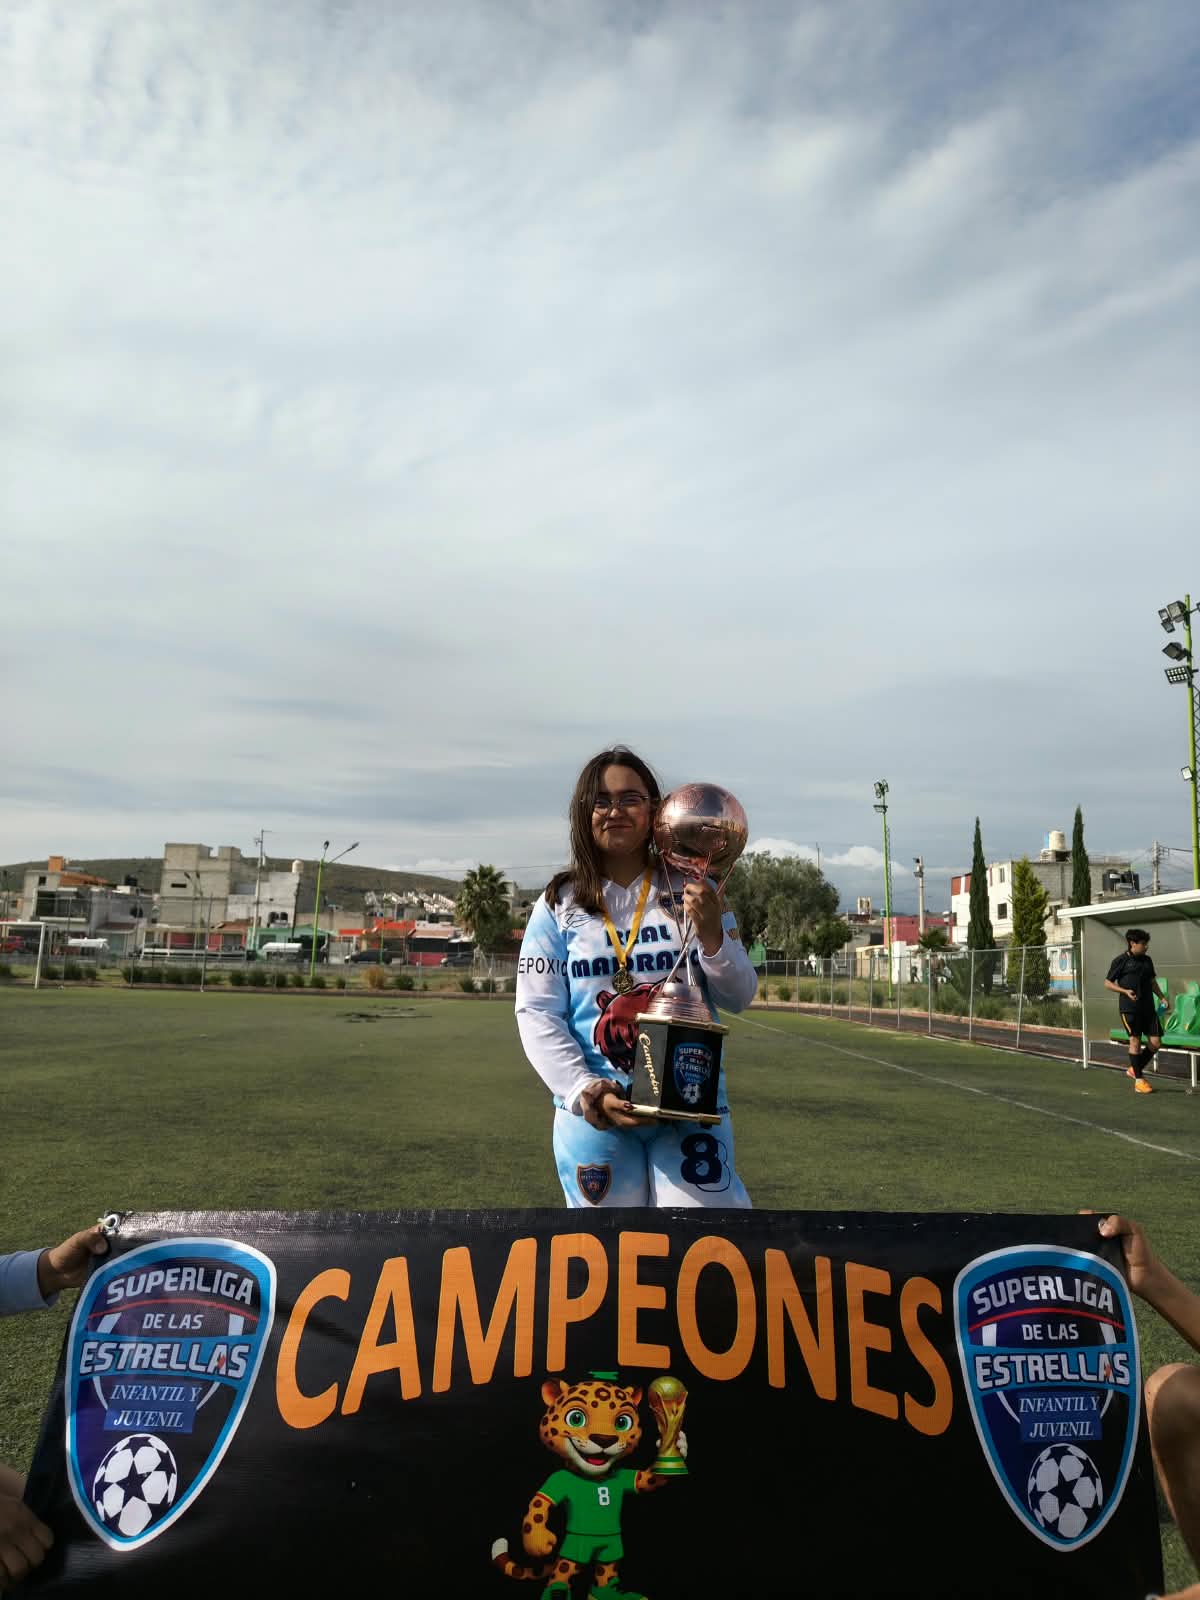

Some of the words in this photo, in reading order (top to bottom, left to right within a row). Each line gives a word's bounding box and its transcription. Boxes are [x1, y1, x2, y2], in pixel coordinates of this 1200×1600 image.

[680, 1133, 722, 1185] 8
[106, 1267, 254, 1305] SUPERLIGA
[973, 1275, 1114, 1316] SUPERLIGA
[142, 1313, 165, 1330] DE
[168, 1313, 204, 1330] LAS
[275, 1231, 953, 1436] CAMPEONES
[1021, 1323, 1043, 1341] DE
[1047, 1323, 1079, 1341] LAS
[79, 1341, 250, 1378] ESTRELLAS
[975, 1352, 1130, 1389] ESTRELLAS
[110, 1384, 188, 1402] INFANTIL
[190, 1386, 203, 1402] Y
[1019, 1396, 1086, 1413] INFANTIL
[1087, 1396, 1100, 1411] Y
[113, 1409, 184, 1428] JUVENIL
[1029, 1421, 1094, 1439] JUVENIL
[597, 1486, 610, 1506] 8
